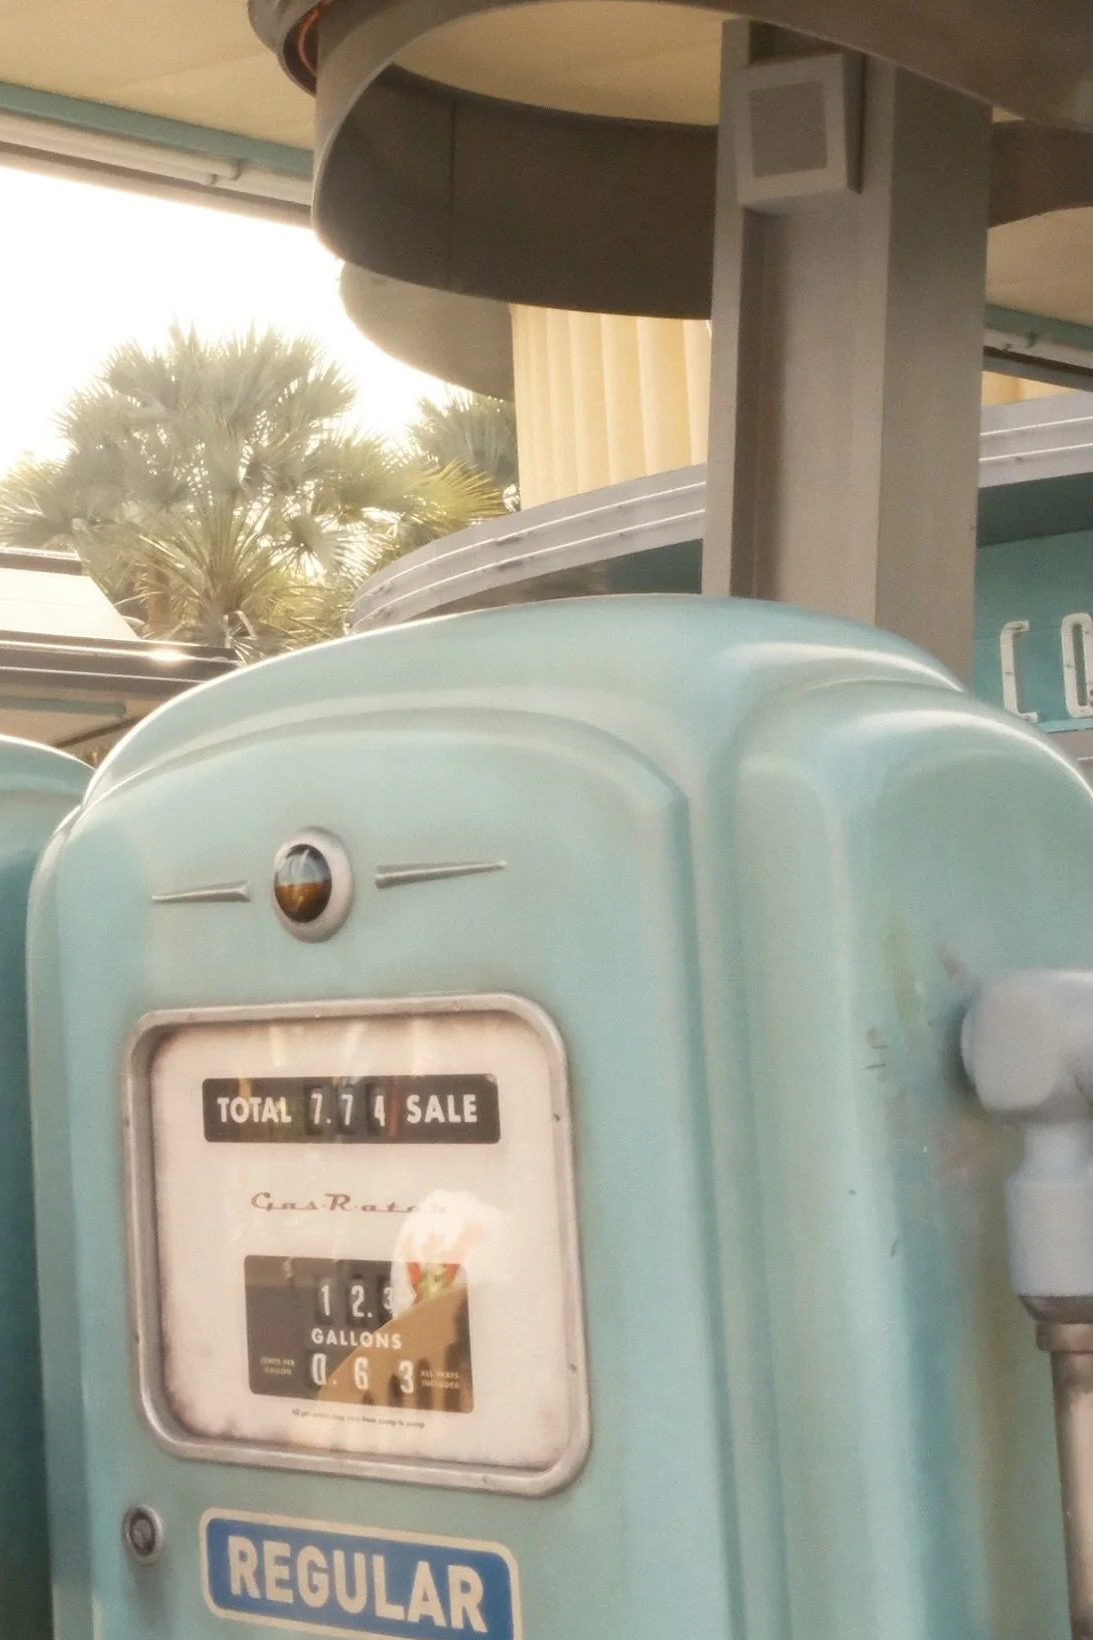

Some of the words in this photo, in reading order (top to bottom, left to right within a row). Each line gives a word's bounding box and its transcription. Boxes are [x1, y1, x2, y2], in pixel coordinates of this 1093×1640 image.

[217, 1096, 292, 1123] TOTAL
[406, 1094, 477, 1123] SALE
[311, 1327, 403, 1350] GALLONS
[227, 1534, 488, 1634] REGULAR
